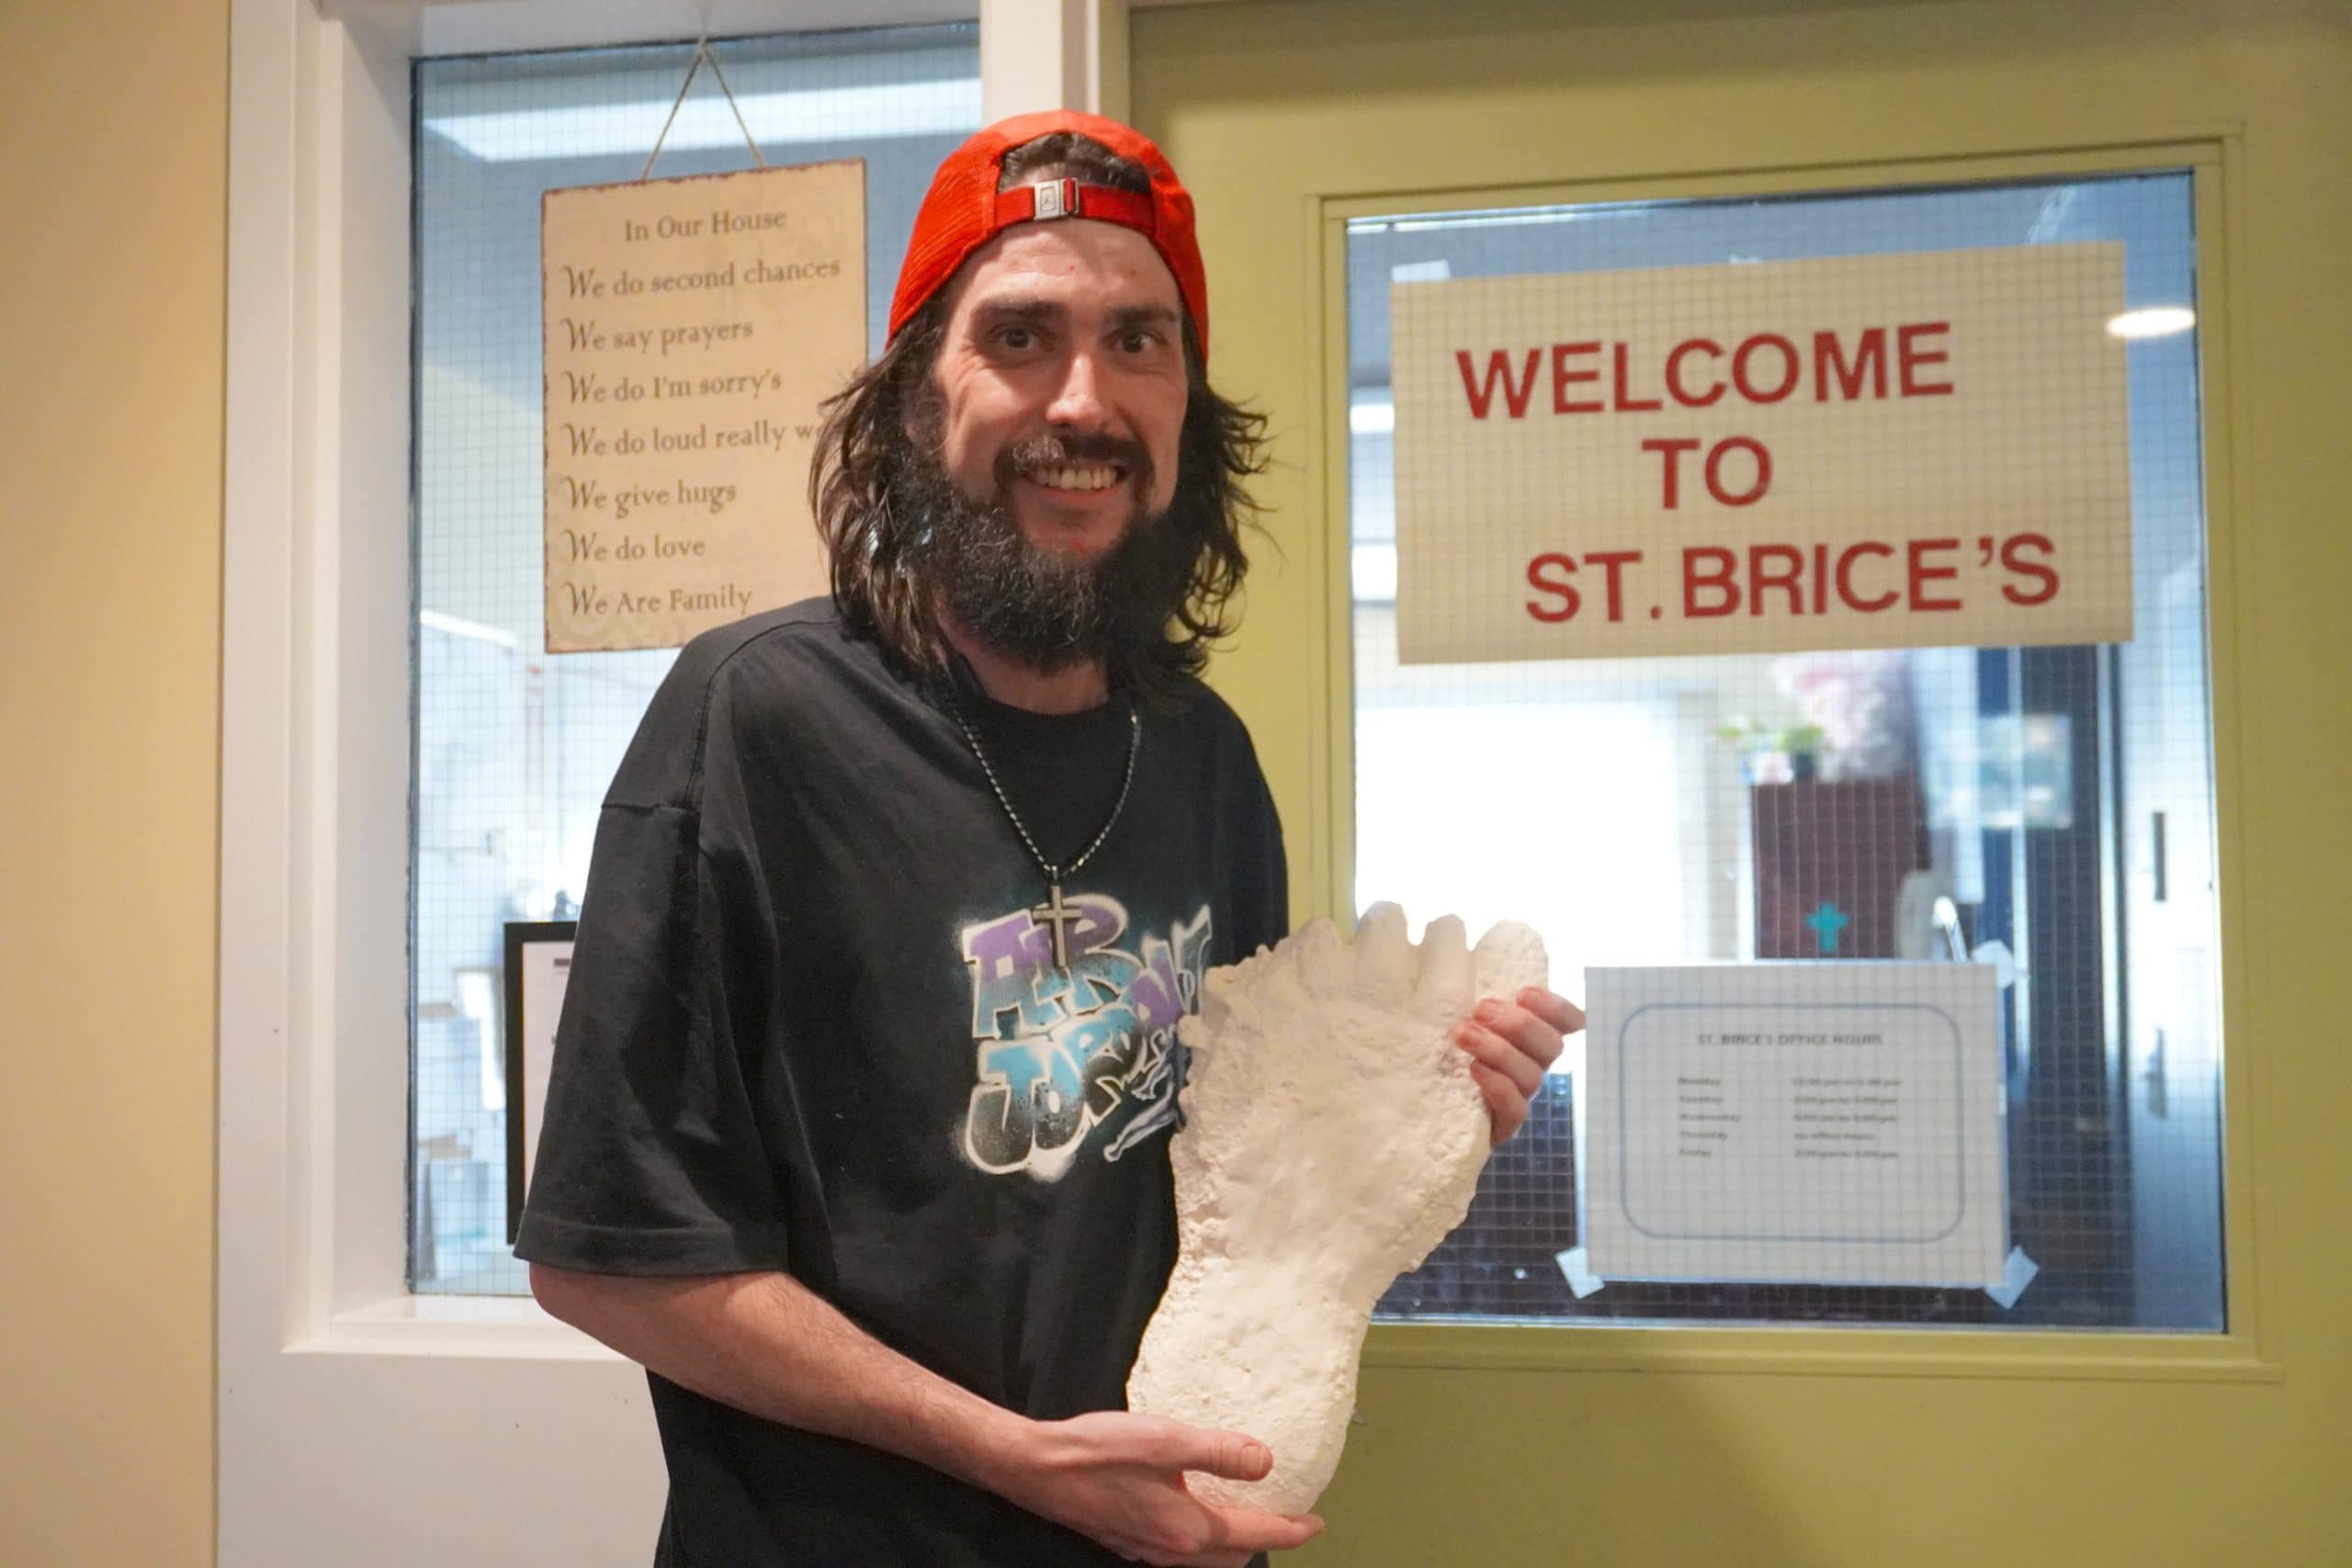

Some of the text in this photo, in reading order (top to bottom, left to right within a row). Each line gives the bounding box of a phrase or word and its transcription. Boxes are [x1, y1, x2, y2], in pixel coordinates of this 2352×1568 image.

[625, 210, 786, 242] In Our House
[560, 258, 841, 299] We do second chances
[560, 318, 753, 356] We say prayers
[561, 369, 782, 404] We do I'm sorry's
[1455, 321, 1955, 420] WELCOME
[562, 423, 606, 457] We
[615, 430, 644, 455] do
[653, 423, 706, 452] loud
[716, 419, 786, 451] really
[1641, 435, 1774, 510] TO
[562, 477, 737, 519] We give hugs
[562, 529, 706, 562] We do love
[1525, 533, 2061, 624] ST. BRICE'S
[563, 581, 752, 615] We Are Family
